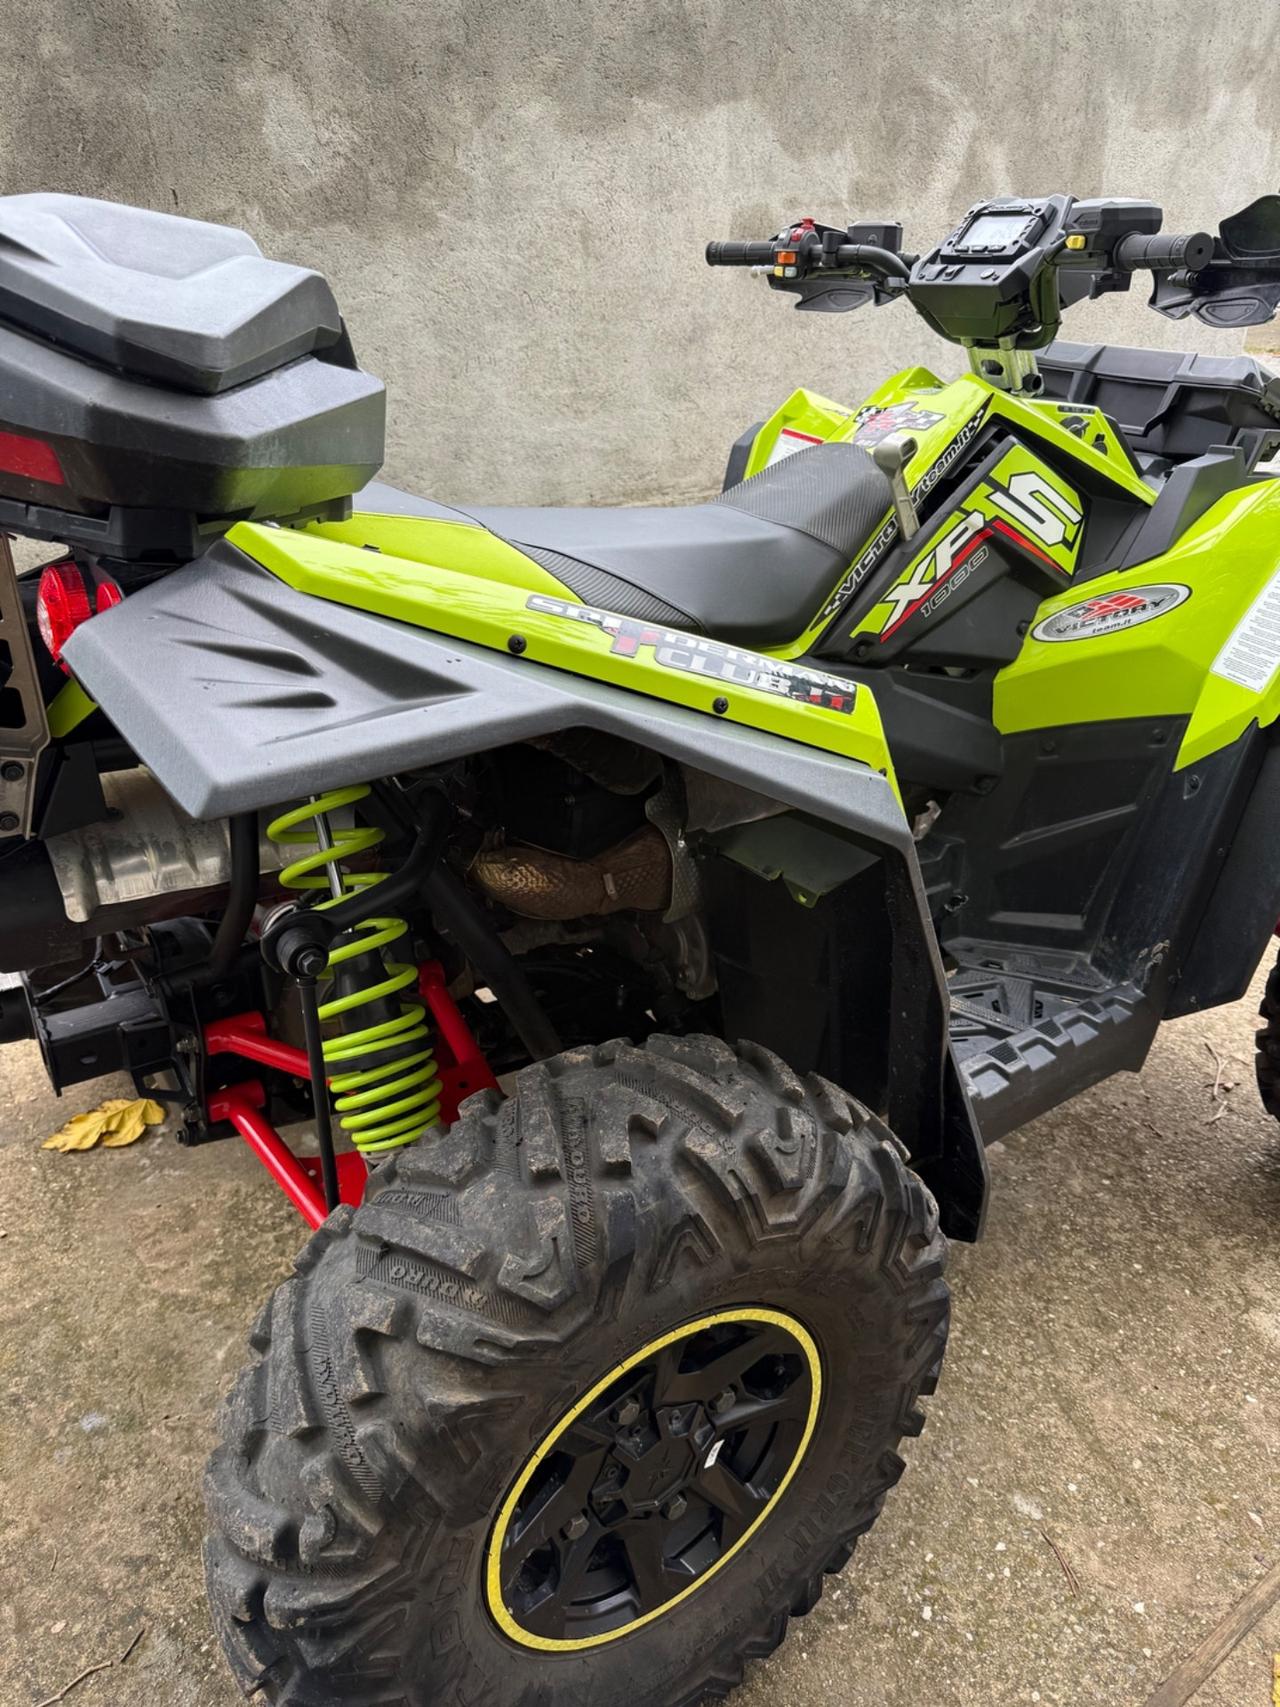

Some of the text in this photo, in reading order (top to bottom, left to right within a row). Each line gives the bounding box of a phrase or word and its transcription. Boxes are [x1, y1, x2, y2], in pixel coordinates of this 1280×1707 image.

[879, 510, 985, 635] XP
[920, 545, 989, 618] 1000
[1055, 596, 1170, 634] VICTORY
